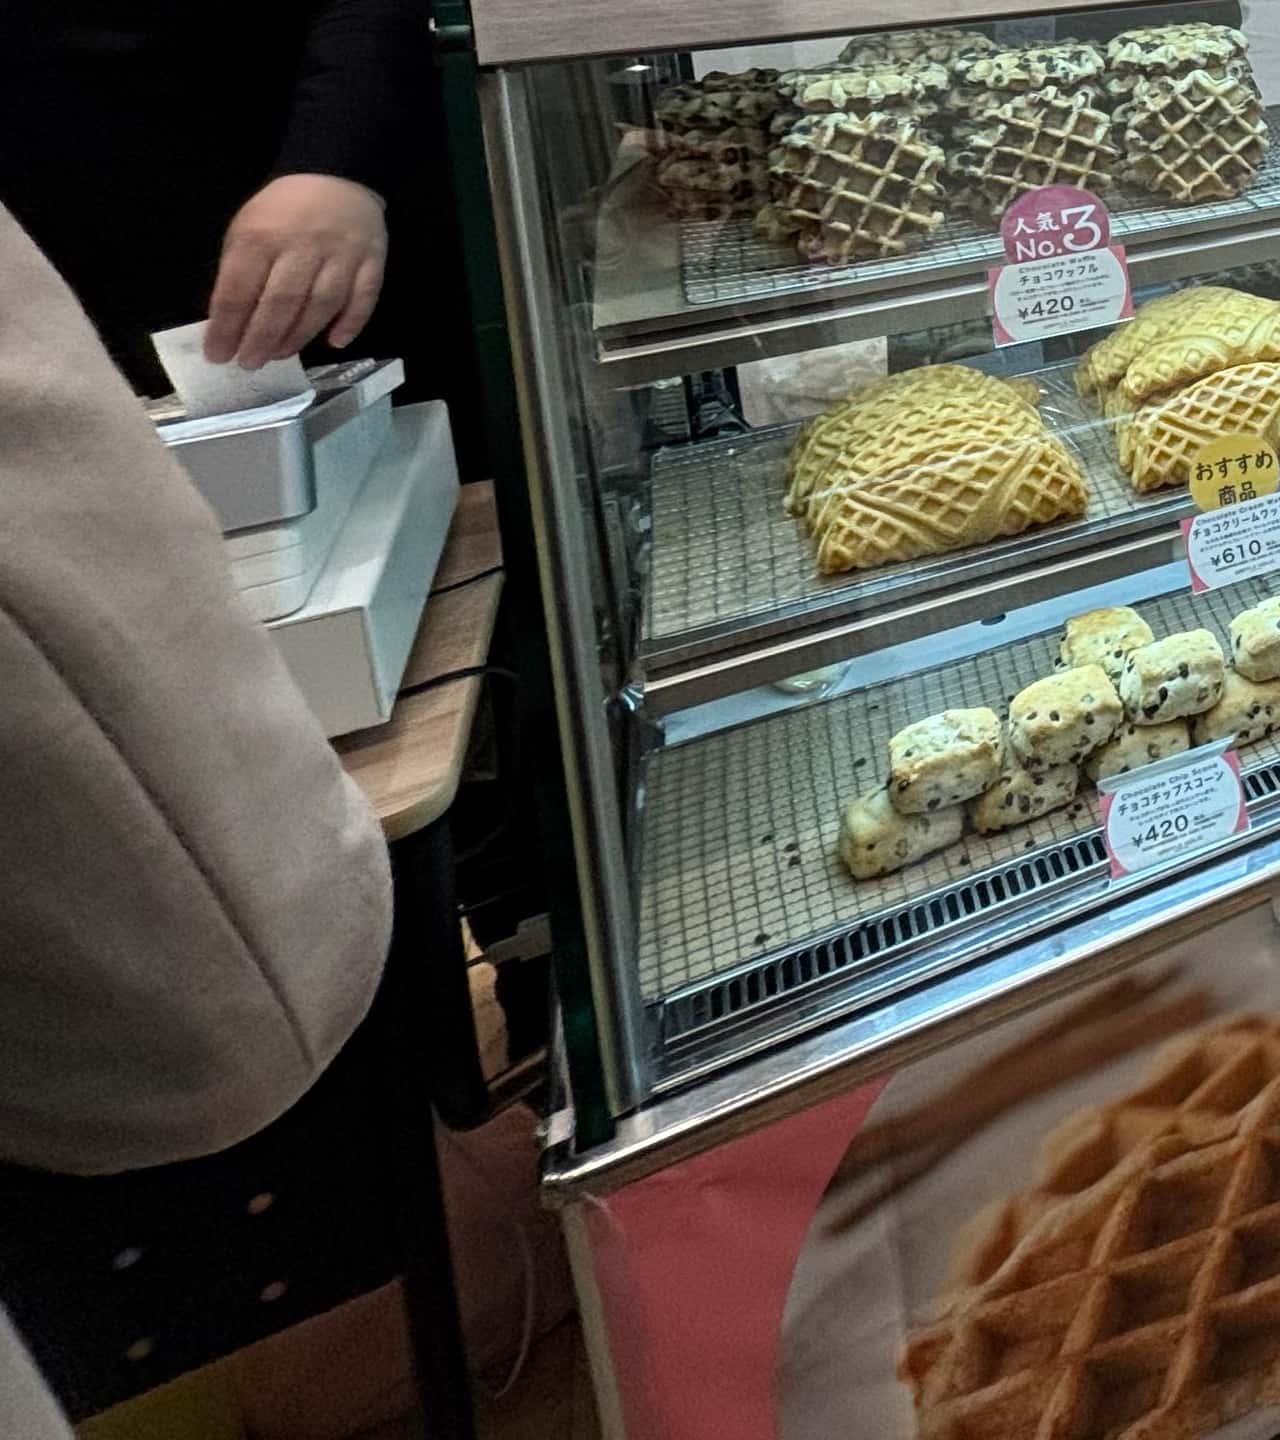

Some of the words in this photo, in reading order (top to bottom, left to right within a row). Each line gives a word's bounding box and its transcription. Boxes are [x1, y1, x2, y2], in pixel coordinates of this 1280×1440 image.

[1013, 212, 1060, 236] 人気
[1019, 264, 1098, 286] チョコワッフル
[1017, 295, 1074, 320] ¥420
[1196, 450, 1273, 481] おすすめ
[1218, 481, 1256, 506] 商品
[1210, 540, 1262, 566] ¥610
[1118, 771, 1224, 816] チョコチップスコーン
[1132, 814, 1188, 847] ¥420
